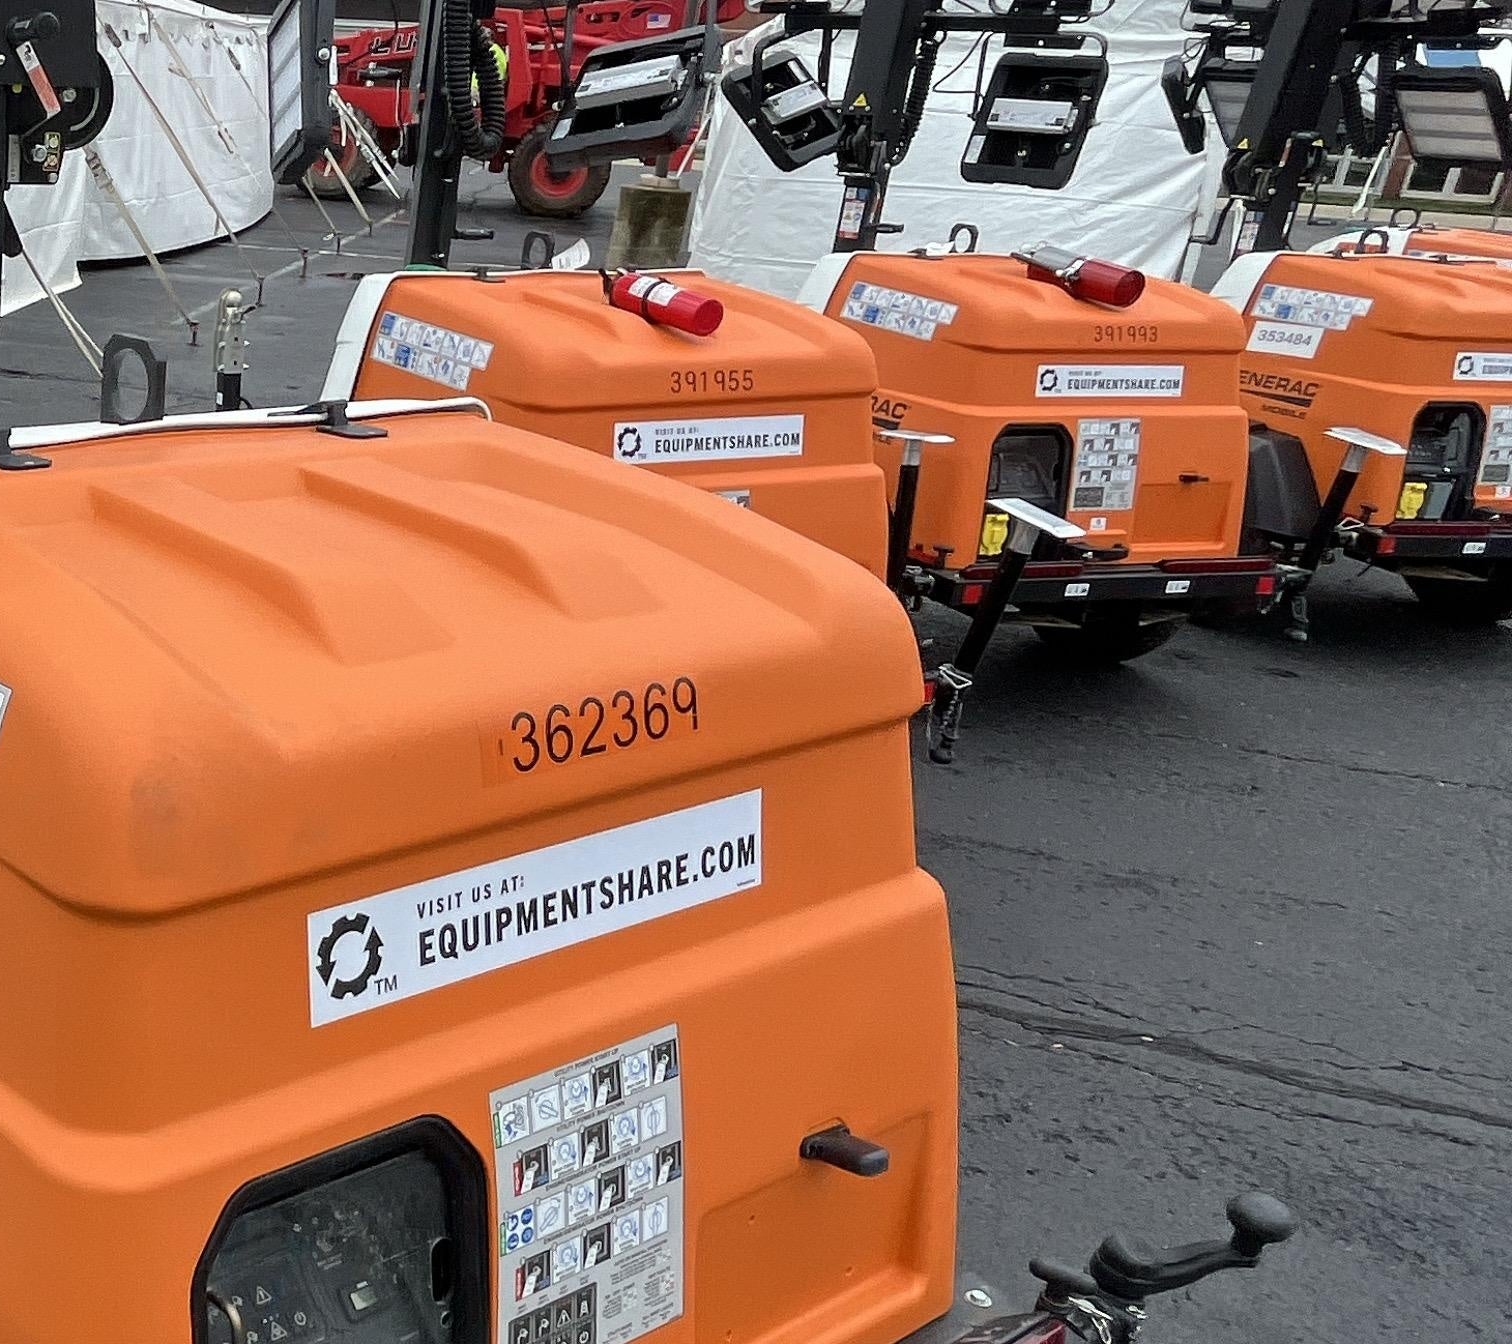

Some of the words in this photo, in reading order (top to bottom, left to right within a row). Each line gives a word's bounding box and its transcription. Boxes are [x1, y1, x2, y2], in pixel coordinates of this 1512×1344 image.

[370, 30, 418, 57] LU
[1094, 325, 1158, 343] 391993
[1257, 329, 1313, 347] 353484
[670, 369, 754, 394] 391955
[1067, 378, 1181, 391] EQUIPMENTSHARE.COM
[1239, 369, 1320, 398] ENERAC
[654, 432, 801, 454] EQUIPMENTSHARE.COM
[511, 675, 698, 773] 362369
[416, 891, 463, 920] VISIT
[472, 883, 493, 906] US
[499, 874, 526, 896] AT:
[418, 833, 756, 968] EQUIPMENTSHARE.COM
[373, 974, 399, 996] TM
